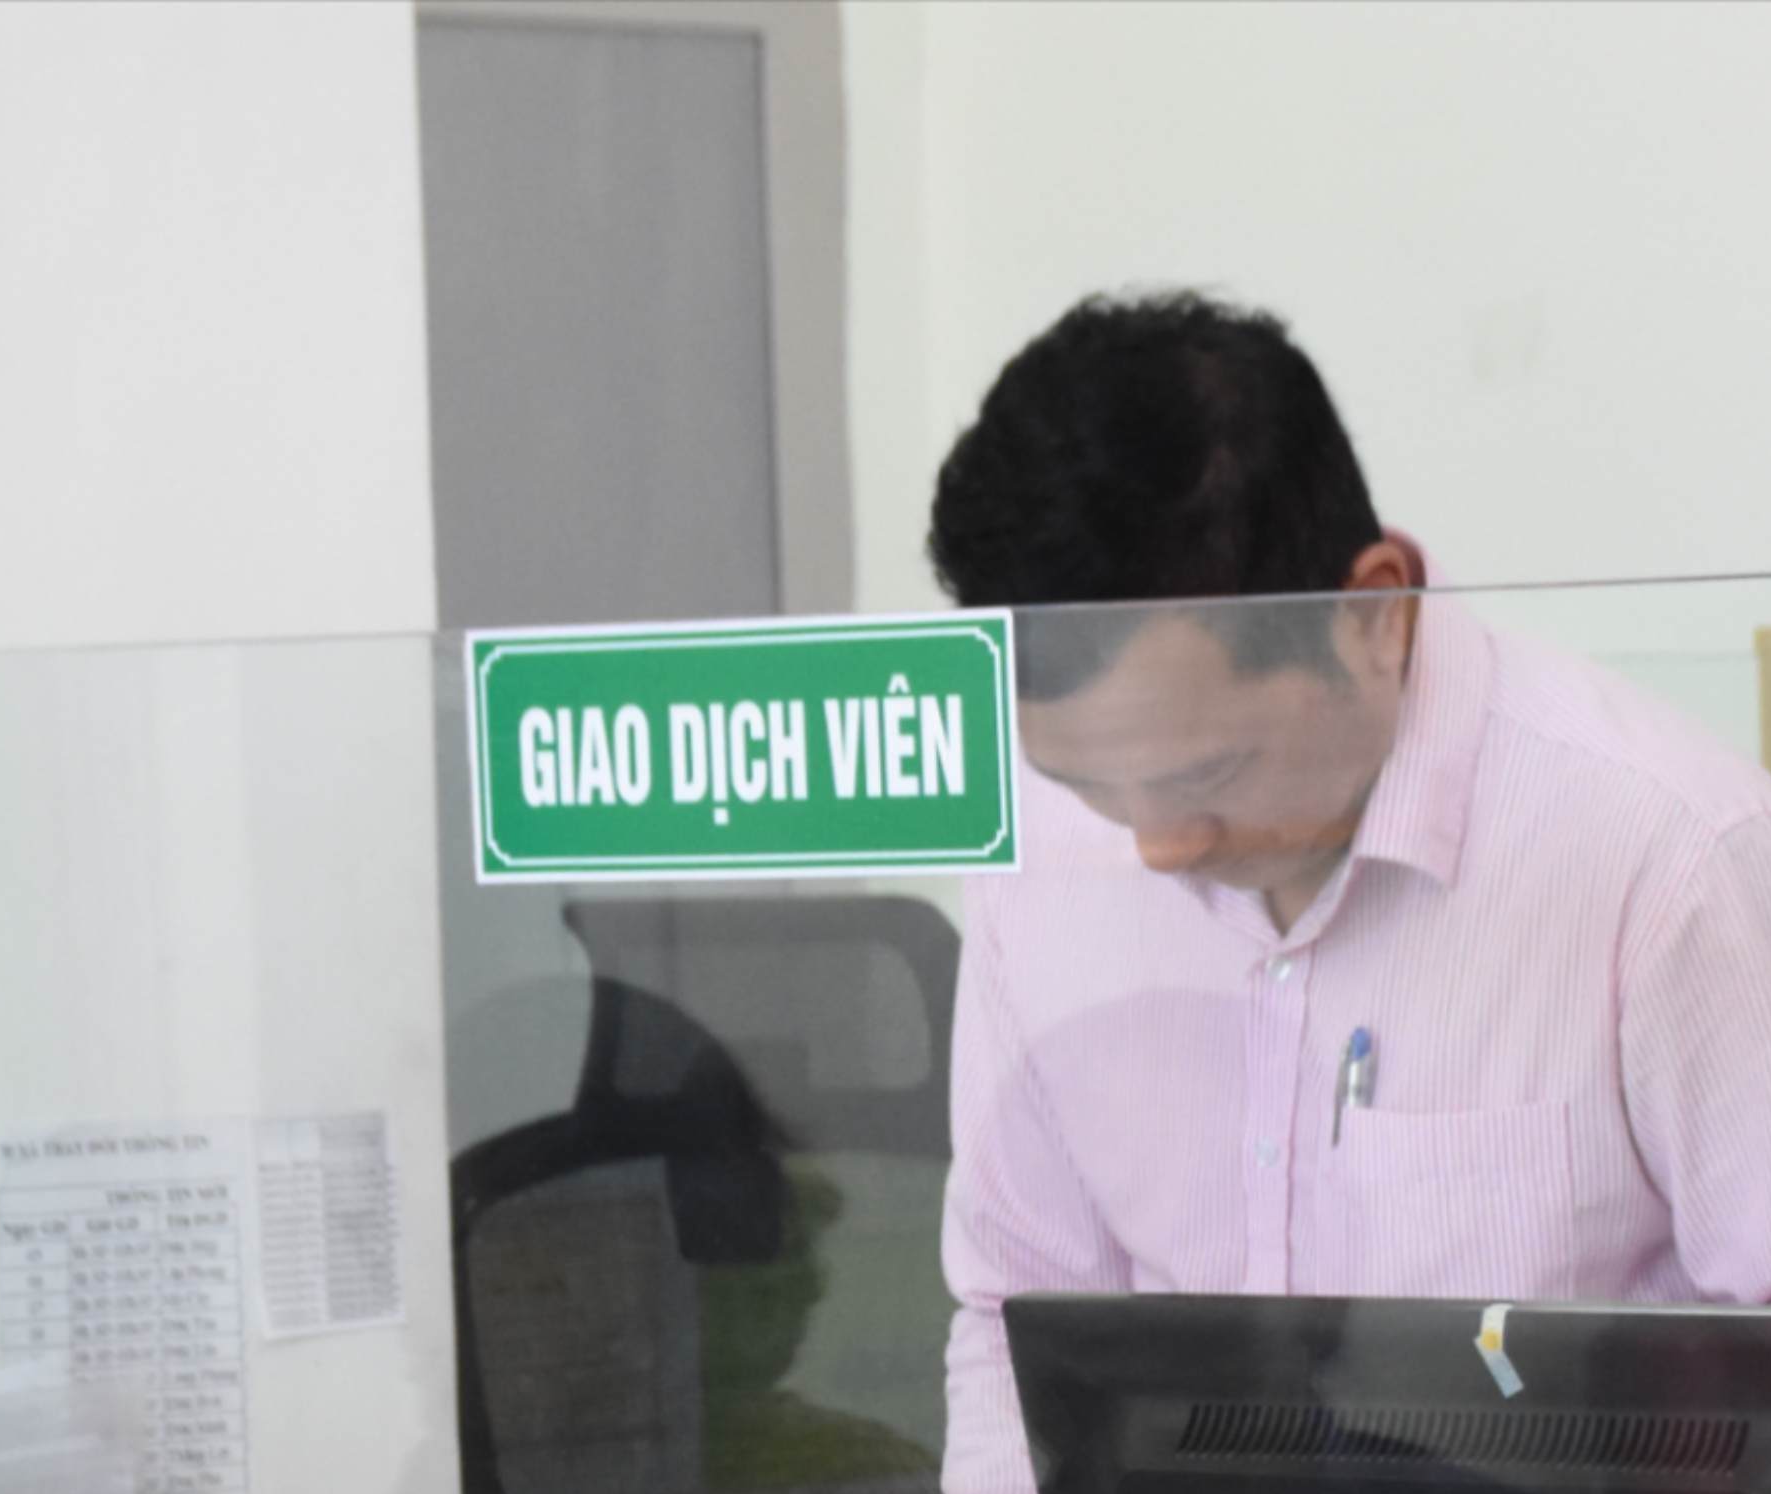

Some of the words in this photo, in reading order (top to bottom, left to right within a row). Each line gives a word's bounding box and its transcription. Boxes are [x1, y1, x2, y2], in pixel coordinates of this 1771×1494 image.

[519, 703, 652, 807] GIAO
[668, 699, 809, 826] DỊCH
[823, 673, 966, 799] VIÊN
